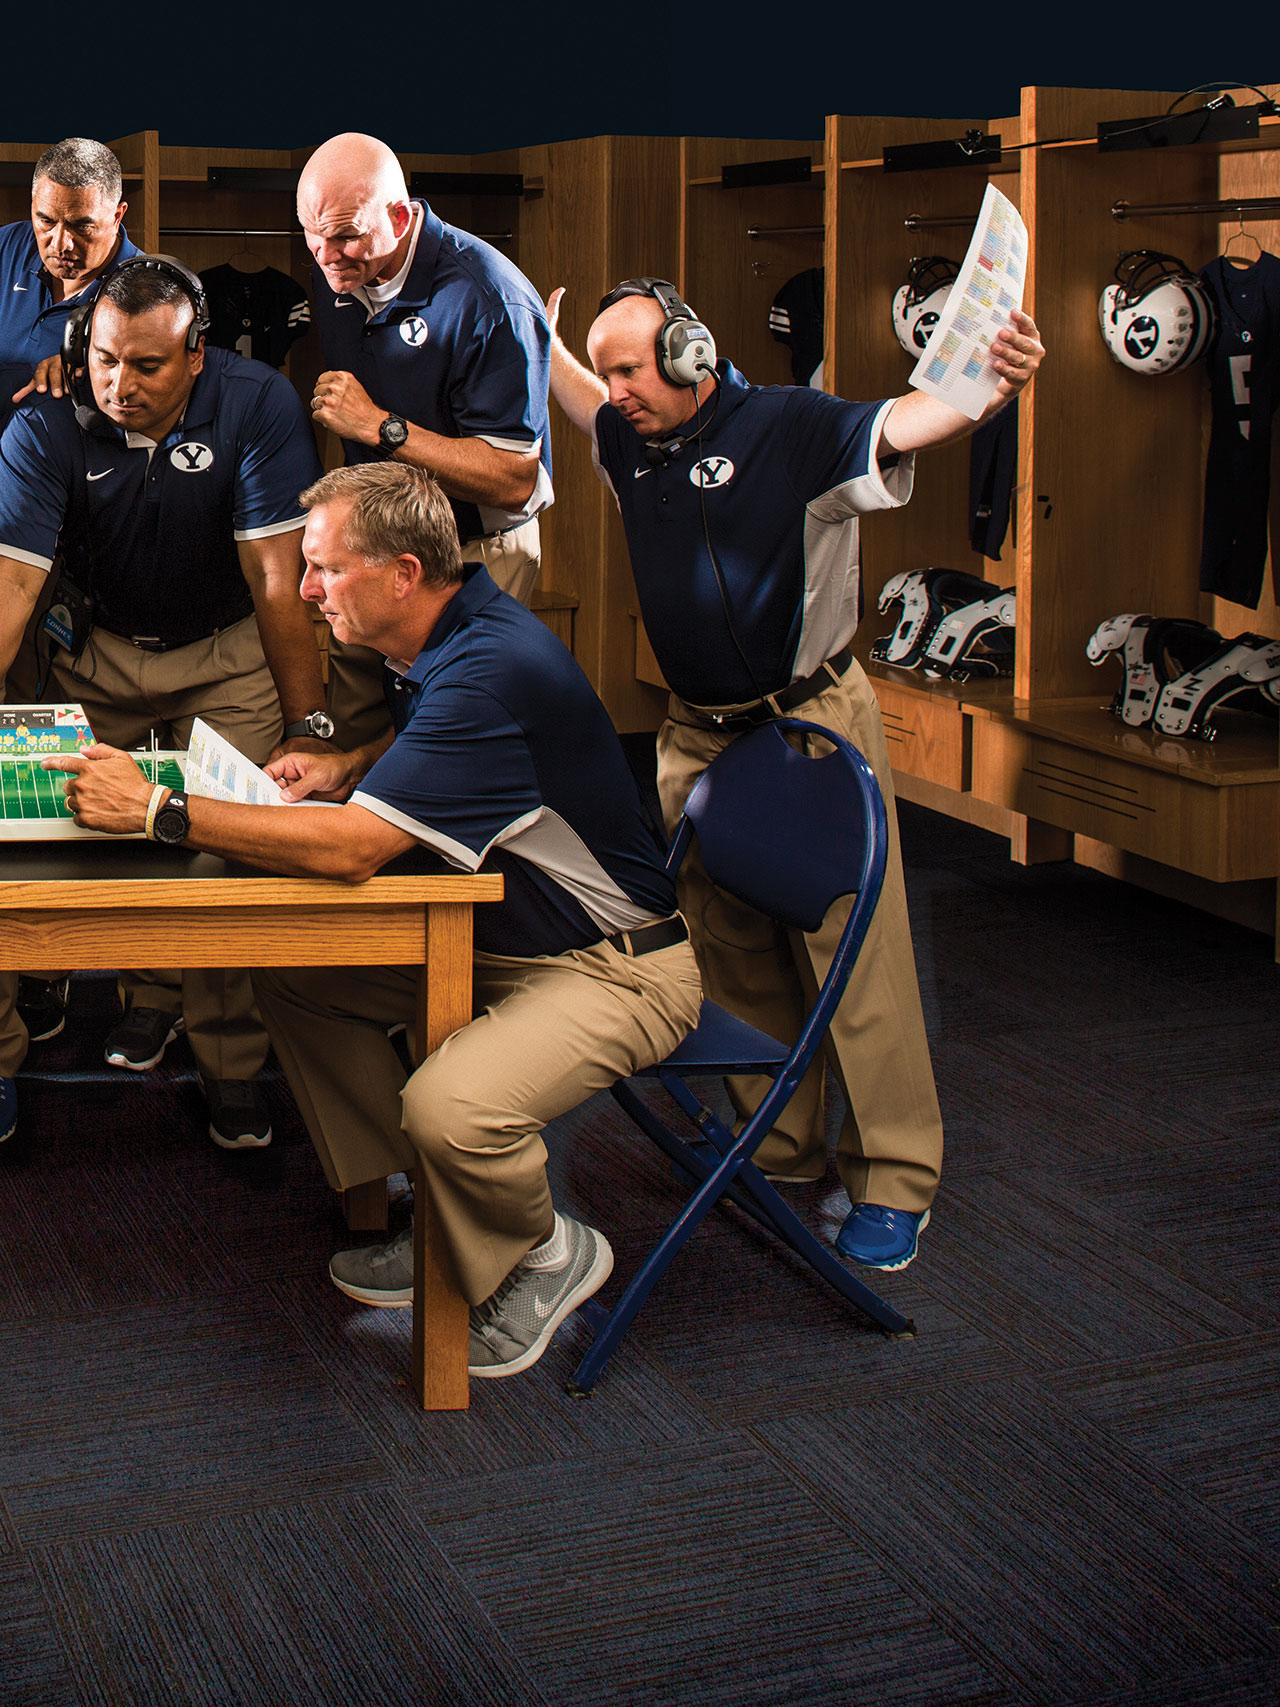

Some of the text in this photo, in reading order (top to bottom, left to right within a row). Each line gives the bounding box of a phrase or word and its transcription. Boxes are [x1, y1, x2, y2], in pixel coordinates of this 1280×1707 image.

[404, 317, 426, 344] Y
[1126, 324, 1155, 356] Y
[173, 443, 208, 470] Y
[694, 457, 727, 486] Y
